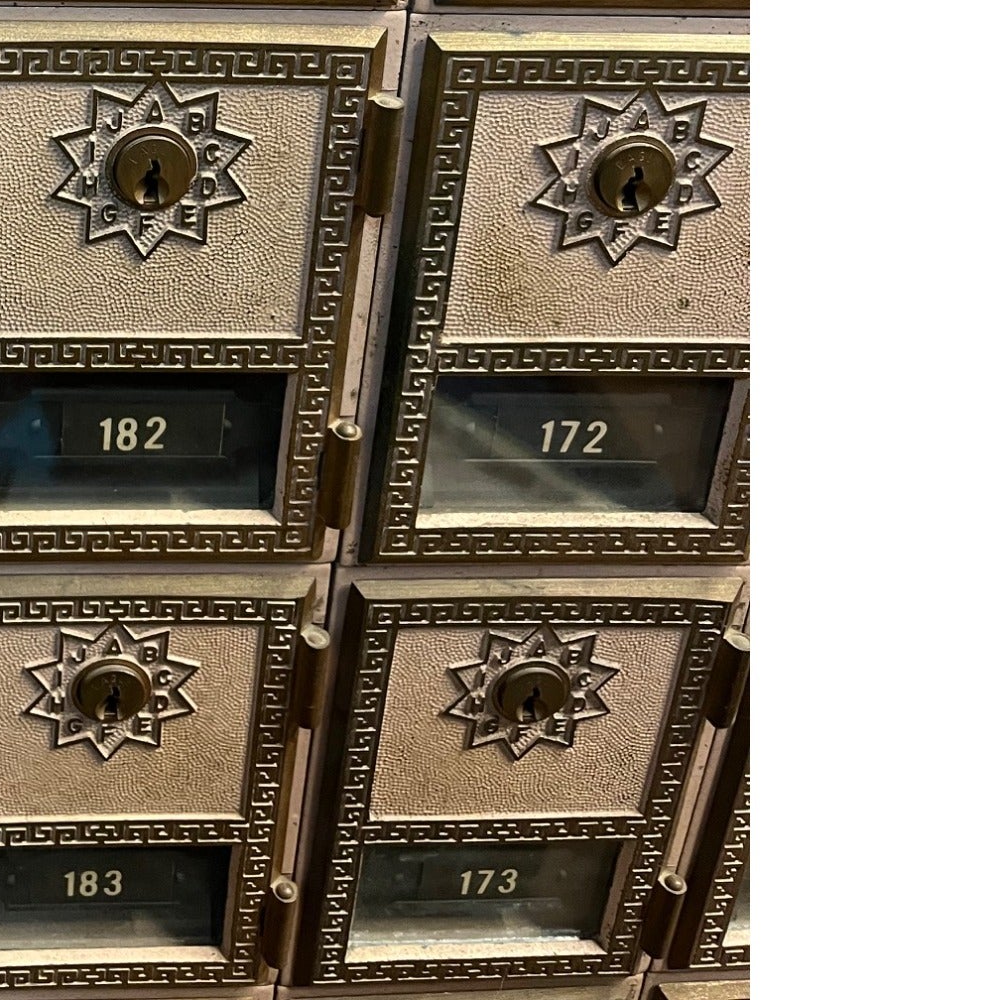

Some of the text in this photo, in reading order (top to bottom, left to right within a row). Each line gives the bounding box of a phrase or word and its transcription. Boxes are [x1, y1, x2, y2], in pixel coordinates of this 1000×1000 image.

[105, 109, 124, 132] J
[145, 97, 165, 124] A
[187, 109, 206, 134] B
[631, 108, 650, 131] A
[589, 116, 611, 140] J
[670, 118, 690, 142] B
[203, 142, 221, 164] C
[683, 150, 701, 171] C
[81, 172, 98, 197] H
[199, 172, 218, 198] D
[557, 180, 579, 200] H
[675, 181, 694, 204] D
[101, 203, 118, 224] G
[139, 213, 155, 237] F
[180, 204, 198, 227] E
[575, 210, 595, 230] G
[651, 210, 673, 233] E
[609, 220, 630, 244] F
[100, 417, 166, 450] 182
[543, 421, 607, 452] 172
[69, 645, 87, 663] J
[104, 636, 123, 656] A
[142, 644, 159, 663] B
[155, 669, 173, 686] C
[48, 694, 65, 713] H
[152, 693, 170, 713] D
[67, 718, 84, 734] G
[99, 723, 118, 745] F
[133, 717, 153, 732] E
[65, 871, 121, 896] 183
[462, 870, 517, 894] 173
